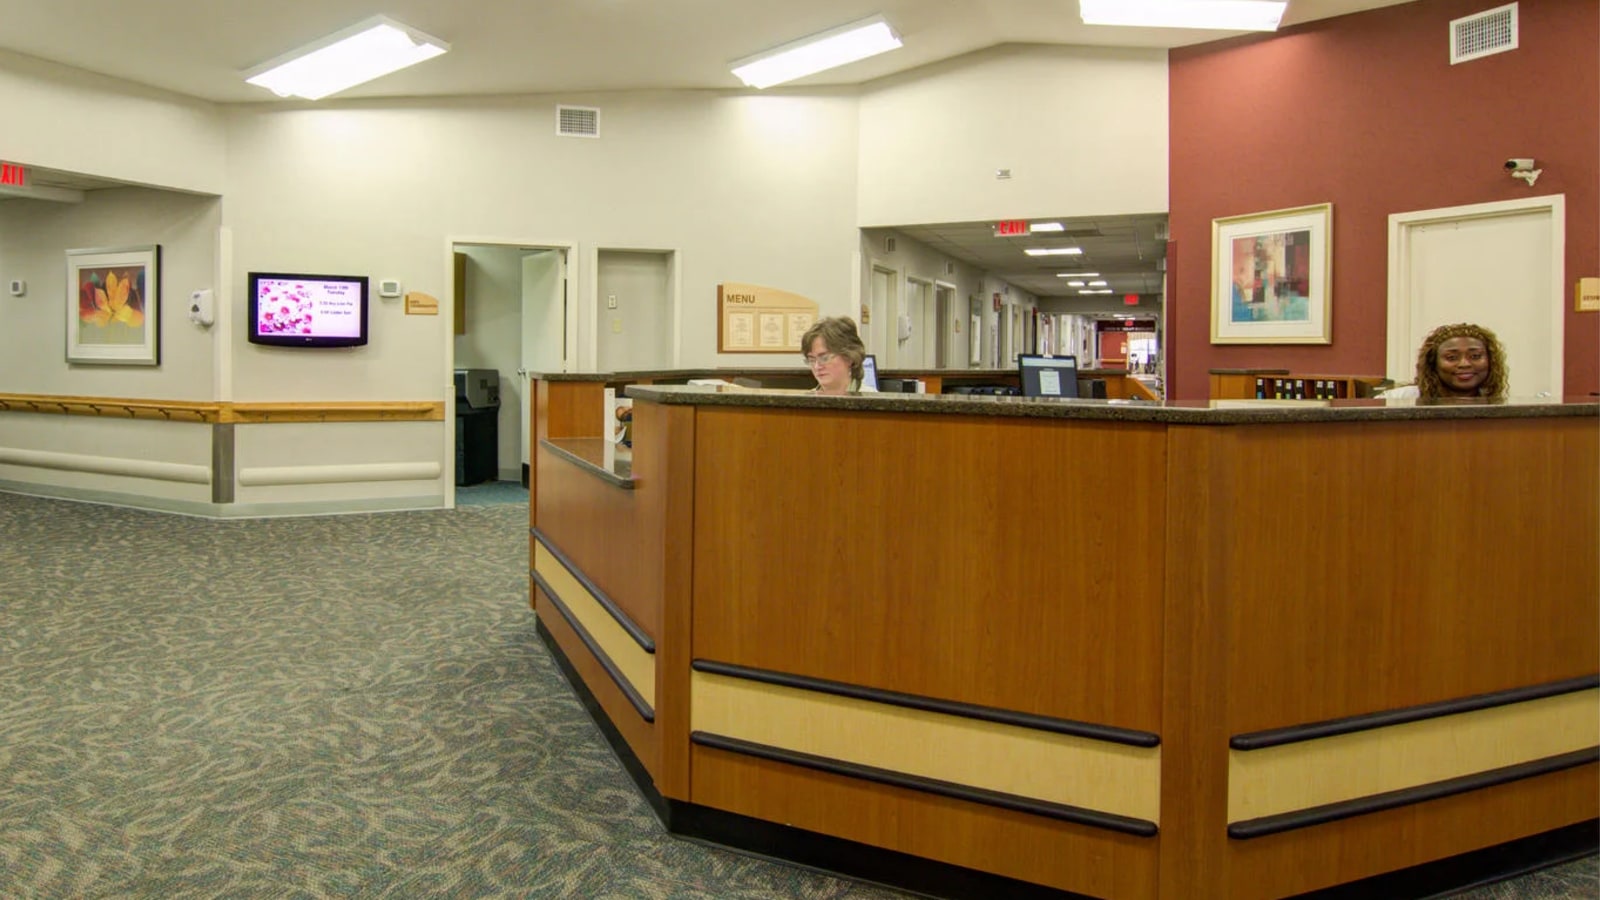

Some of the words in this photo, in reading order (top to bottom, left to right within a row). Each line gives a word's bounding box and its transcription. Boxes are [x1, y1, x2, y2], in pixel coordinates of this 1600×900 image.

[0, 163, 24, 187] XIT
[999, 220, 1025, 235] EXIT
[726, 294, 756, 304] MENU
